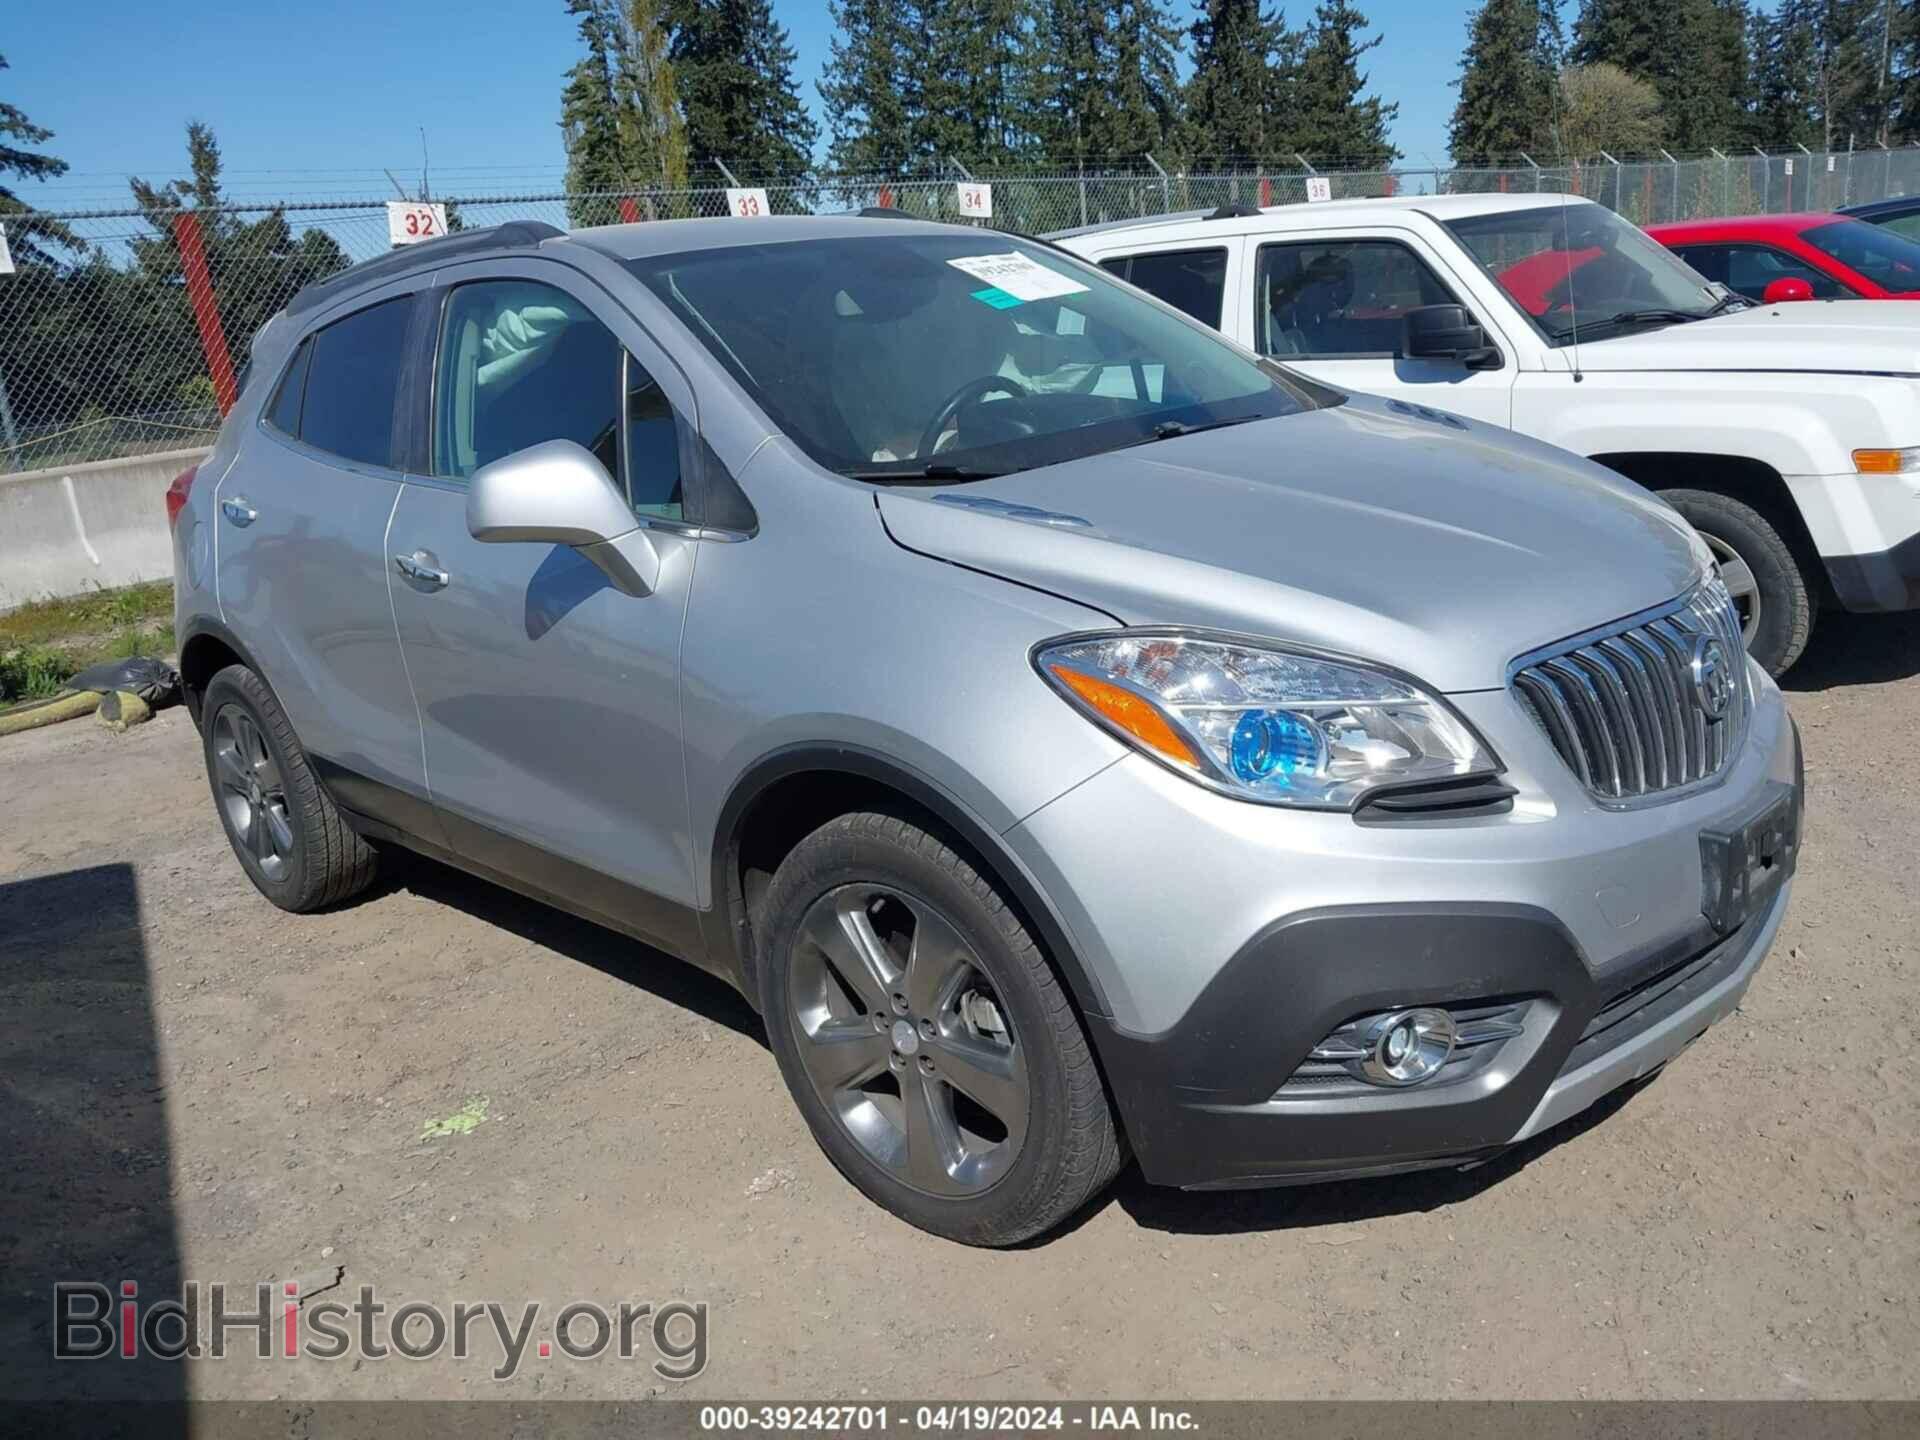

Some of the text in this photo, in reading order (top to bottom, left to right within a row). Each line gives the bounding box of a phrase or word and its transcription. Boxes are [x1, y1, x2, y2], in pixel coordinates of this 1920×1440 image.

[738, 196, 760, 216] 33
[964, 191, 982, 209] 34
[405, 213, 435, 236] 32
